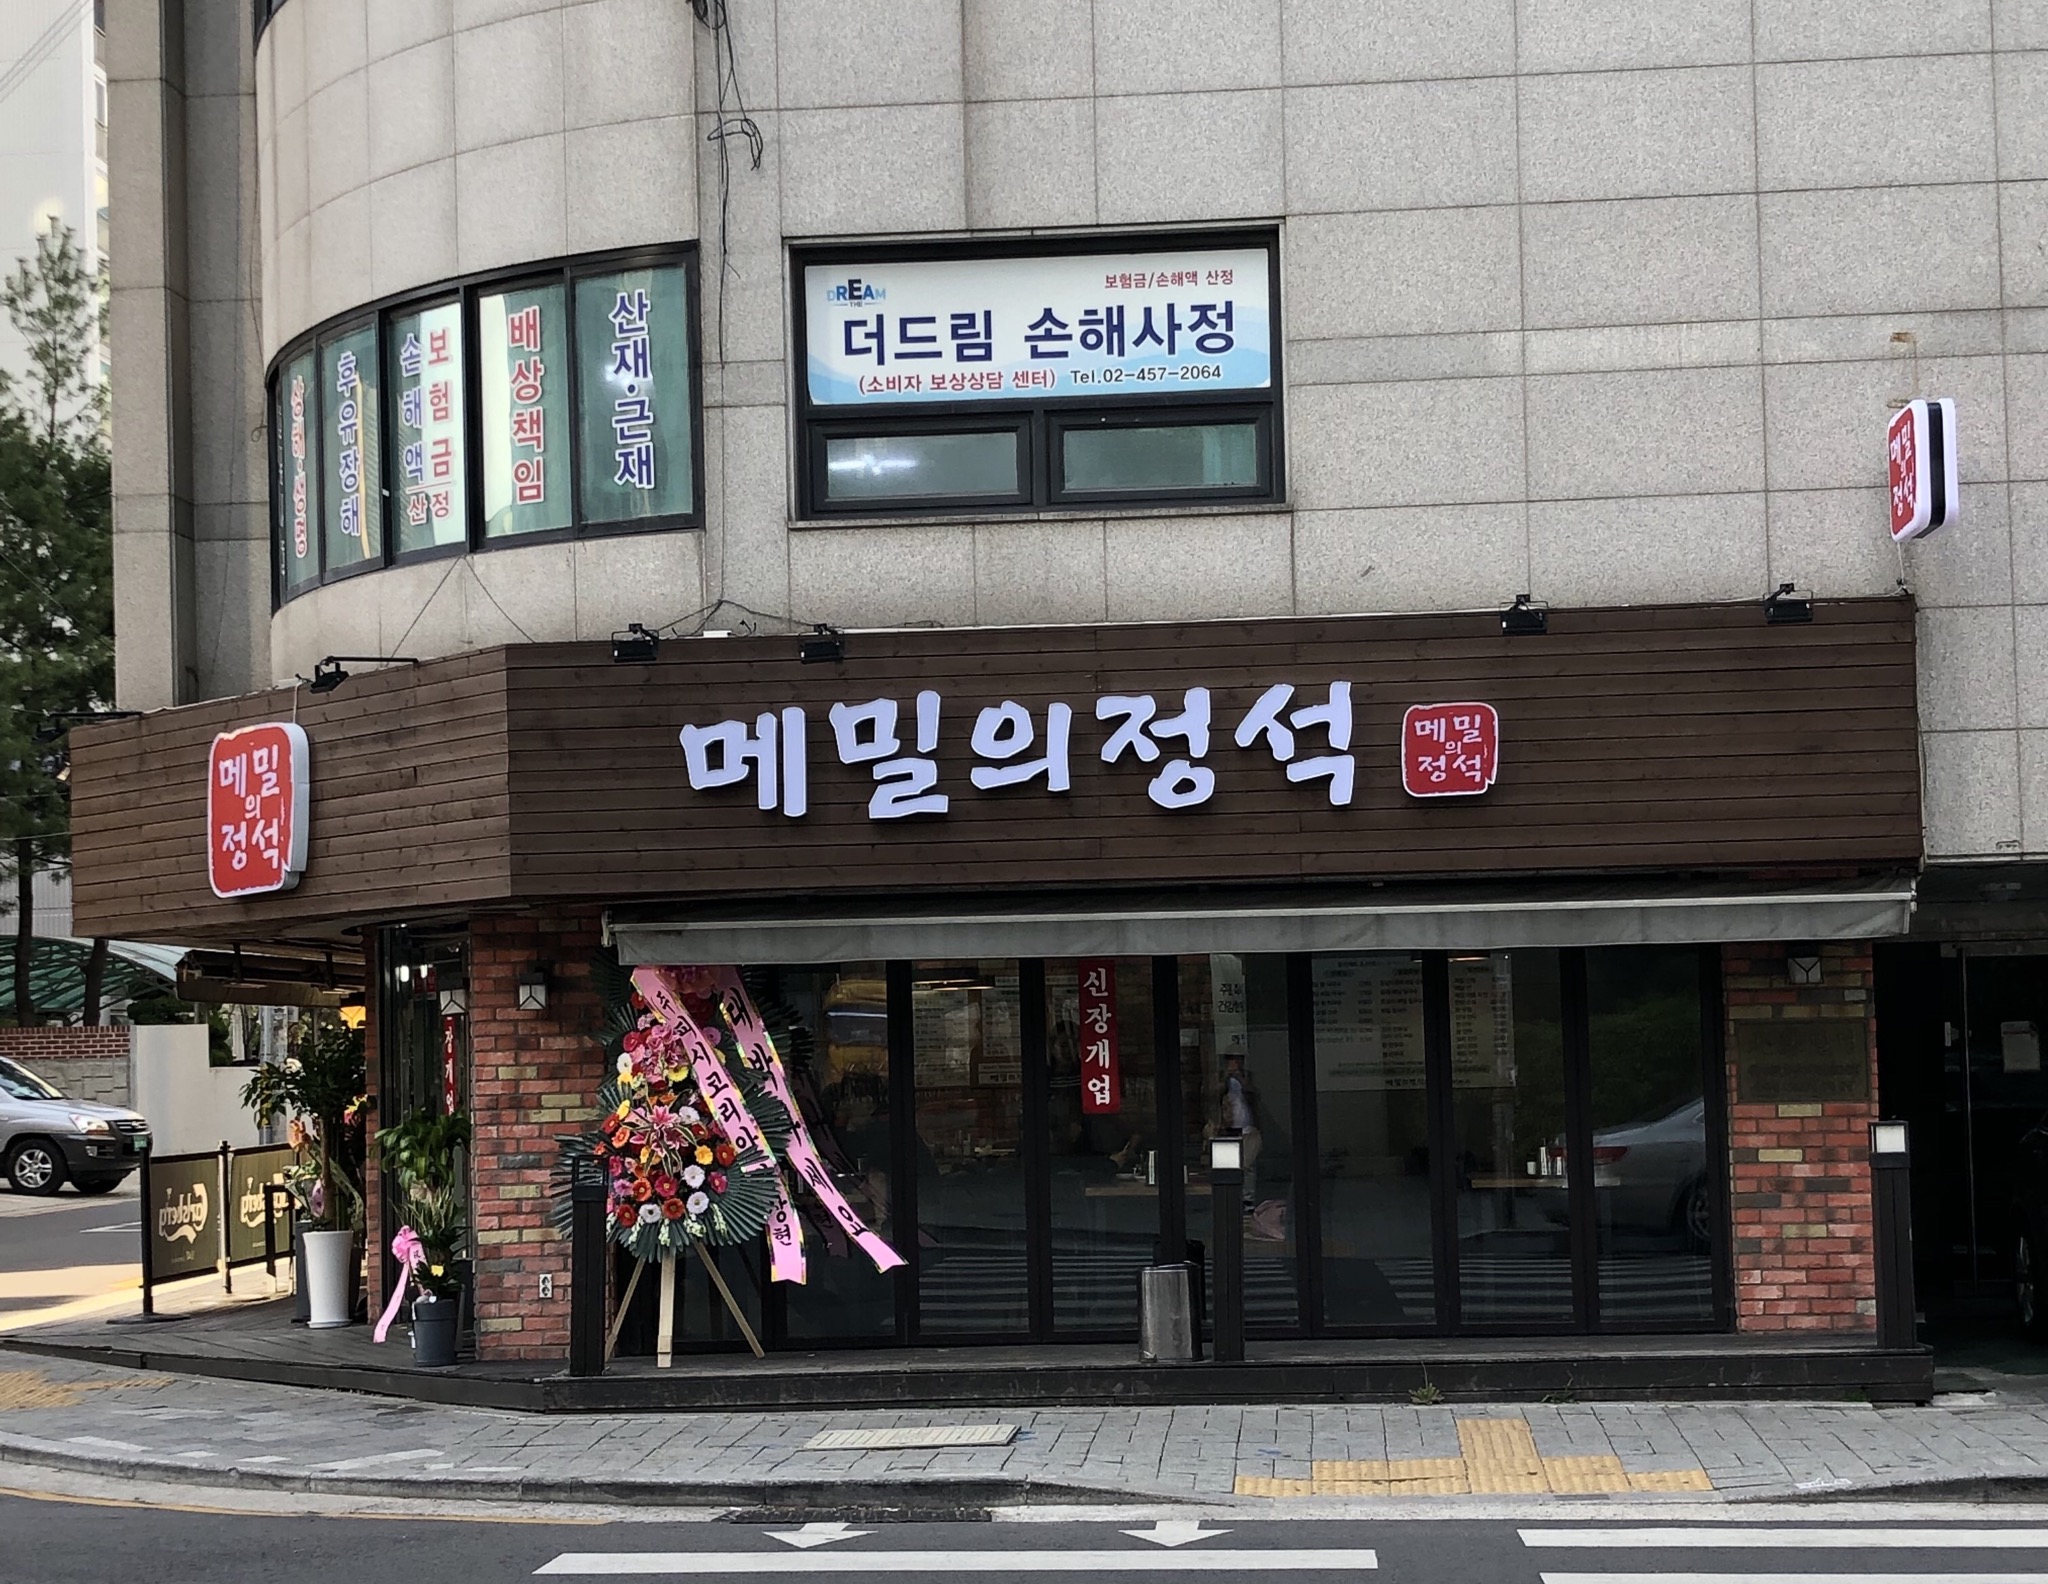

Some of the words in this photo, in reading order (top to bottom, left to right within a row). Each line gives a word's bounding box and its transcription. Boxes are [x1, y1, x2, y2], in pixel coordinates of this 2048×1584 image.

[827, 279, 887, 302] DREAM
[1104, 270, 1199, 290] 보험금/손해액
[1205, 268, 1234, 287] 산정
[843, 309, 994, 366] 더드림
[1023, 300, 1236, 360] 손해사정
[427, 328, 454, 479] 보험금
[509, 306, 545, 504] 배상책임
[858, 374, 922, 396] (소비자
[930, 370, 1004, 392] 보상상담
[1012, 367, 1057, 391] 센터)
[400, 333, 425, 485] 손해액
[337, 351, 361, 537] 후유장해
[406, 490, 451, 525] 산정
[679, 680, 1355, 818] 메밀의정석
[1414, 713, 1483, 744] 메밀
[1444, 740, 1462, 755] 의
[218, 744, 281, 798] 메밀
[1418, 754, 1482, 782] 정석
[244, 794, 261, 819] 의
[221, 818, 280, 870] 정석
[1083, 967, 1113, 1106] 신장개업
[444, 1016, 456, 1116] 장개업
